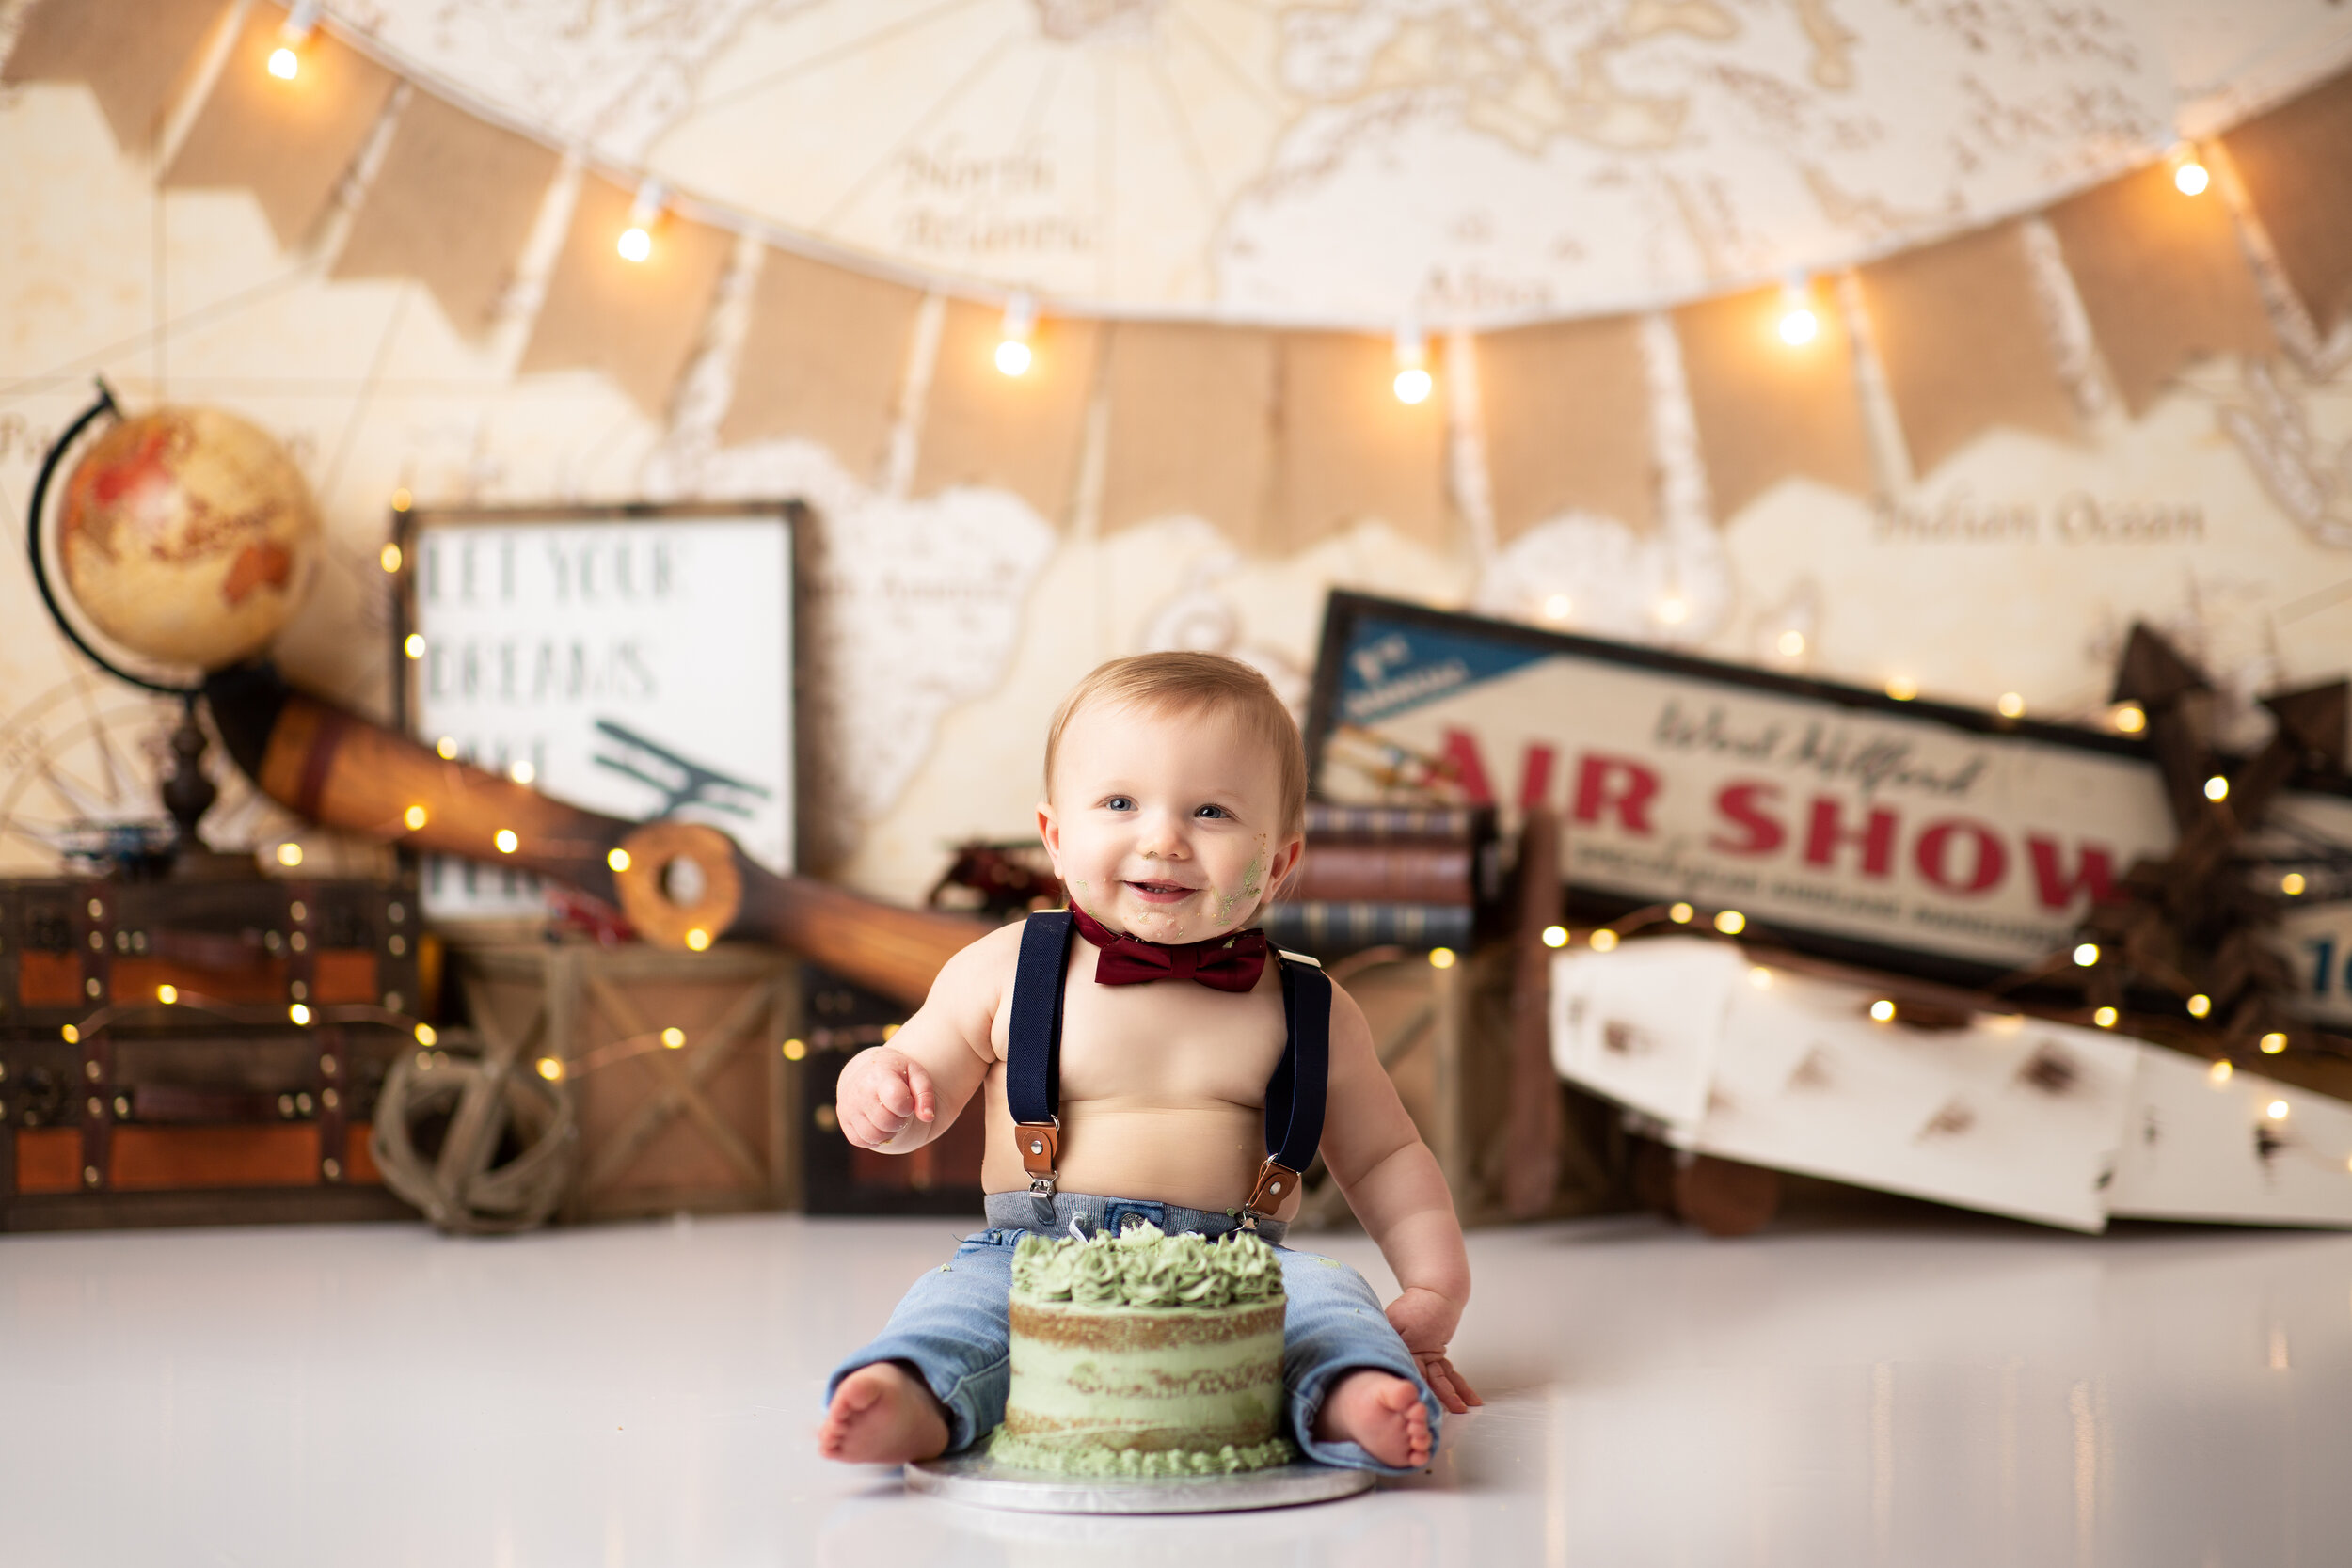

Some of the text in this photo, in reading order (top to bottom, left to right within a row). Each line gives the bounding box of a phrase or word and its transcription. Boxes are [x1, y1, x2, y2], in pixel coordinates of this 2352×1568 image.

[2055, 488, 2208, 545] Ocean
[1423, 724, 1663, 836] AIR
[1707, 775, 2132, 910] SHOW
